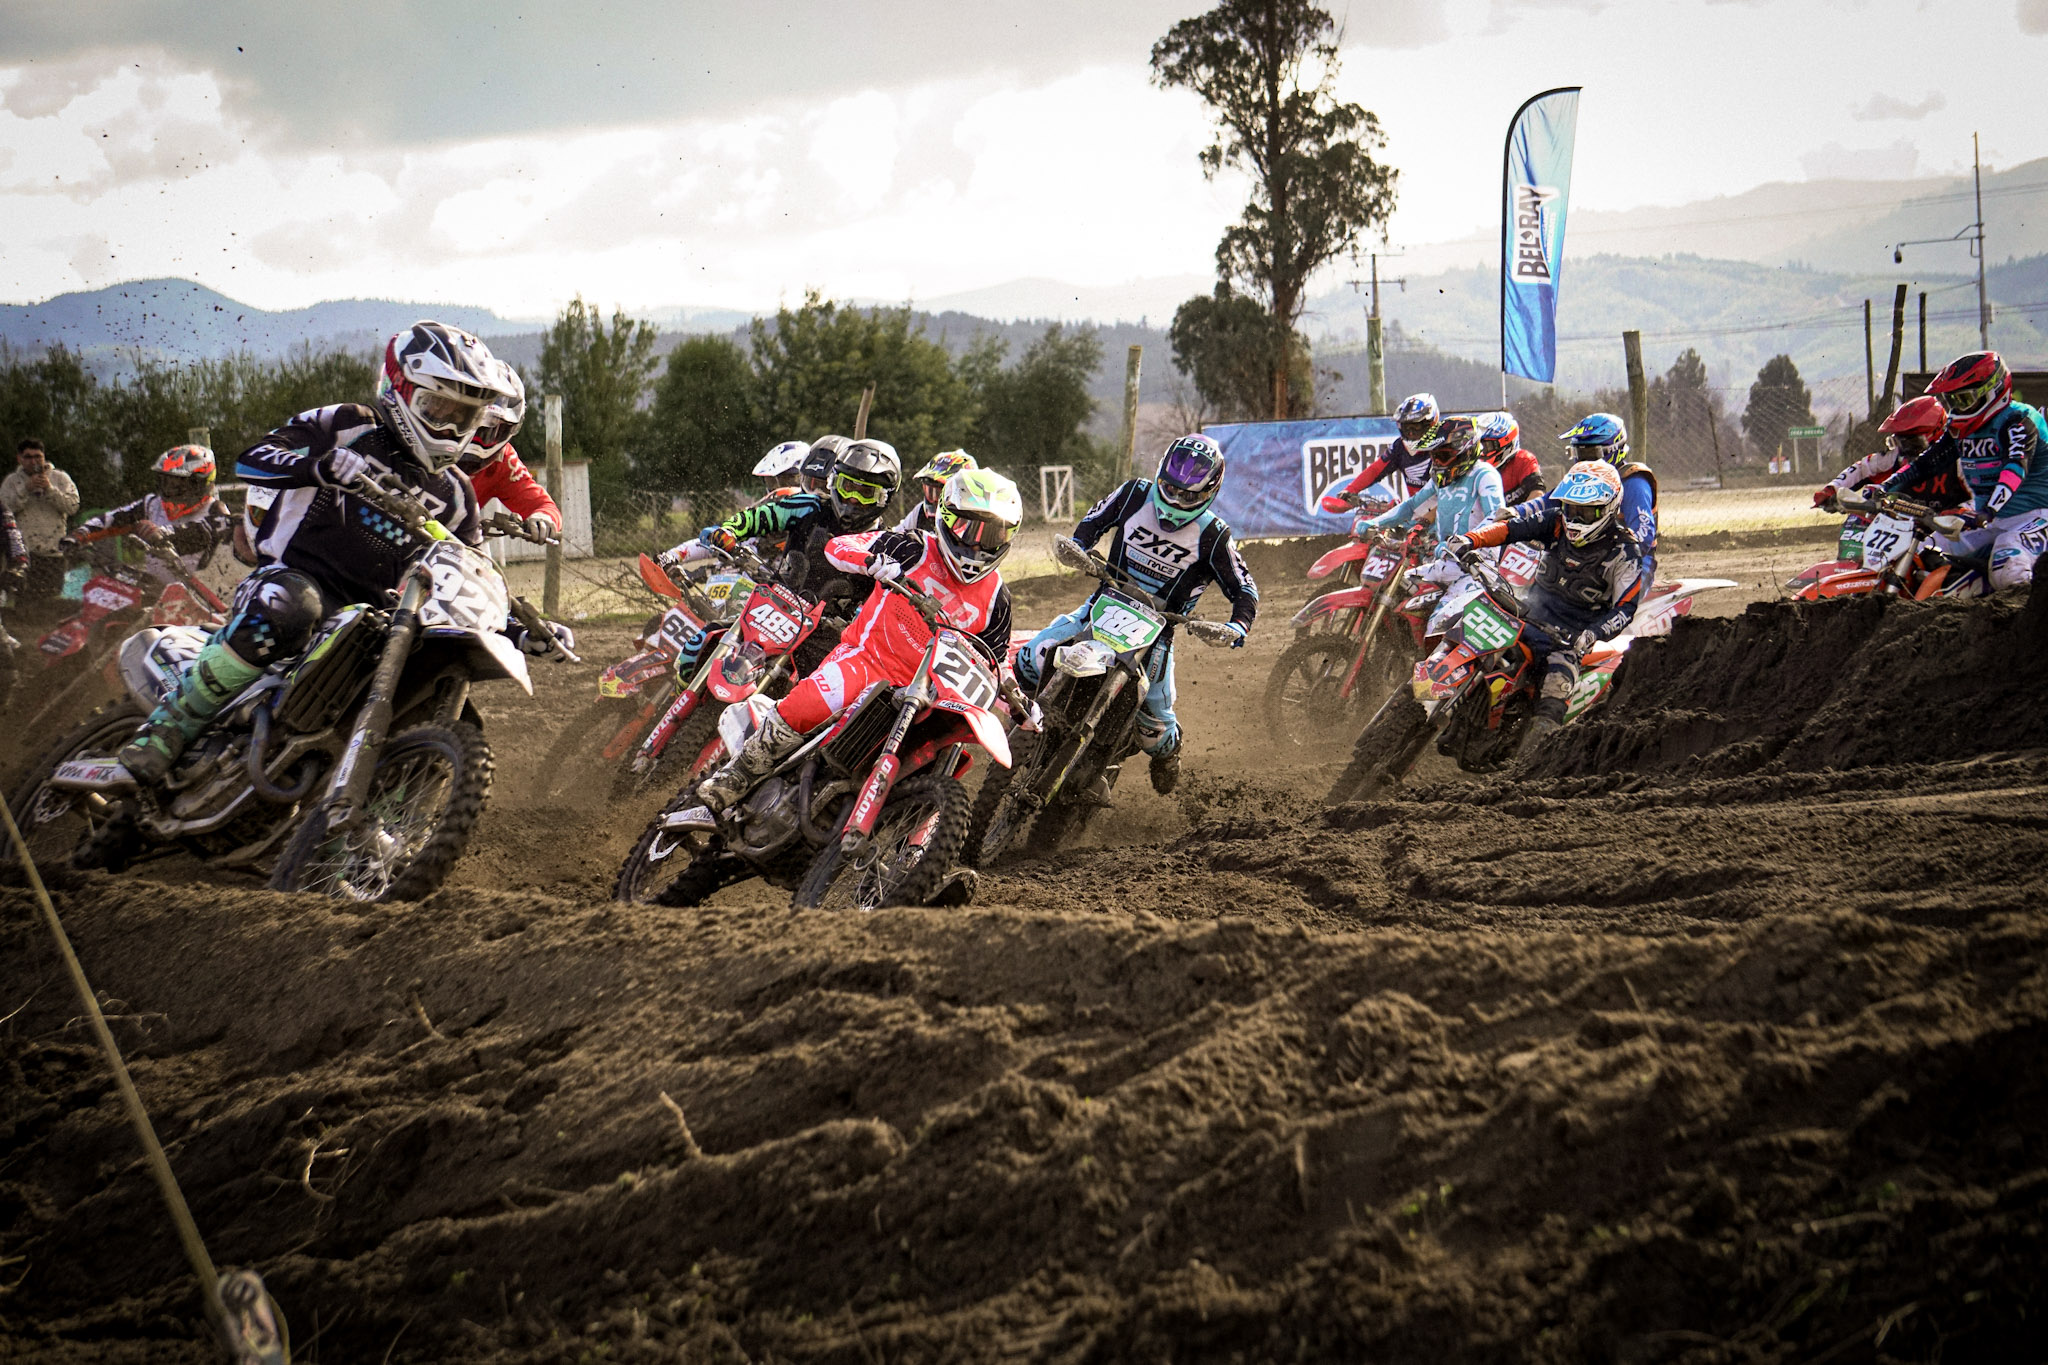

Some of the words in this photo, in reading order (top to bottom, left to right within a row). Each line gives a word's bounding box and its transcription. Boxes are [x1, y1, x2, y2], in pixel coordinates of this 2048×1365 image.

[249, 443, 305, 466] FXR
[1183, 438, 1216, 457] FOX
[1962, 437, 1996, 457] FXR
[1505, 488, 1525, 503] CATI
[1127, 526, 1191, 564] FXR
[1840, 529, 1864, 543] 24
[1866, 529, 1900, 553] 272
[1147, 558, 1175, 576] RACE
[1501, 550, 1538, 580] 501
[1405, 589, 1443, 609] CRF
[748, 620, 783, 646] MARTINEZ
[749, 603, 801, 643] 485
[1092, 605, 1154, 647] 184
[1462, 606, 1514, 649] 225
[932, 651, 993, 709] 211
